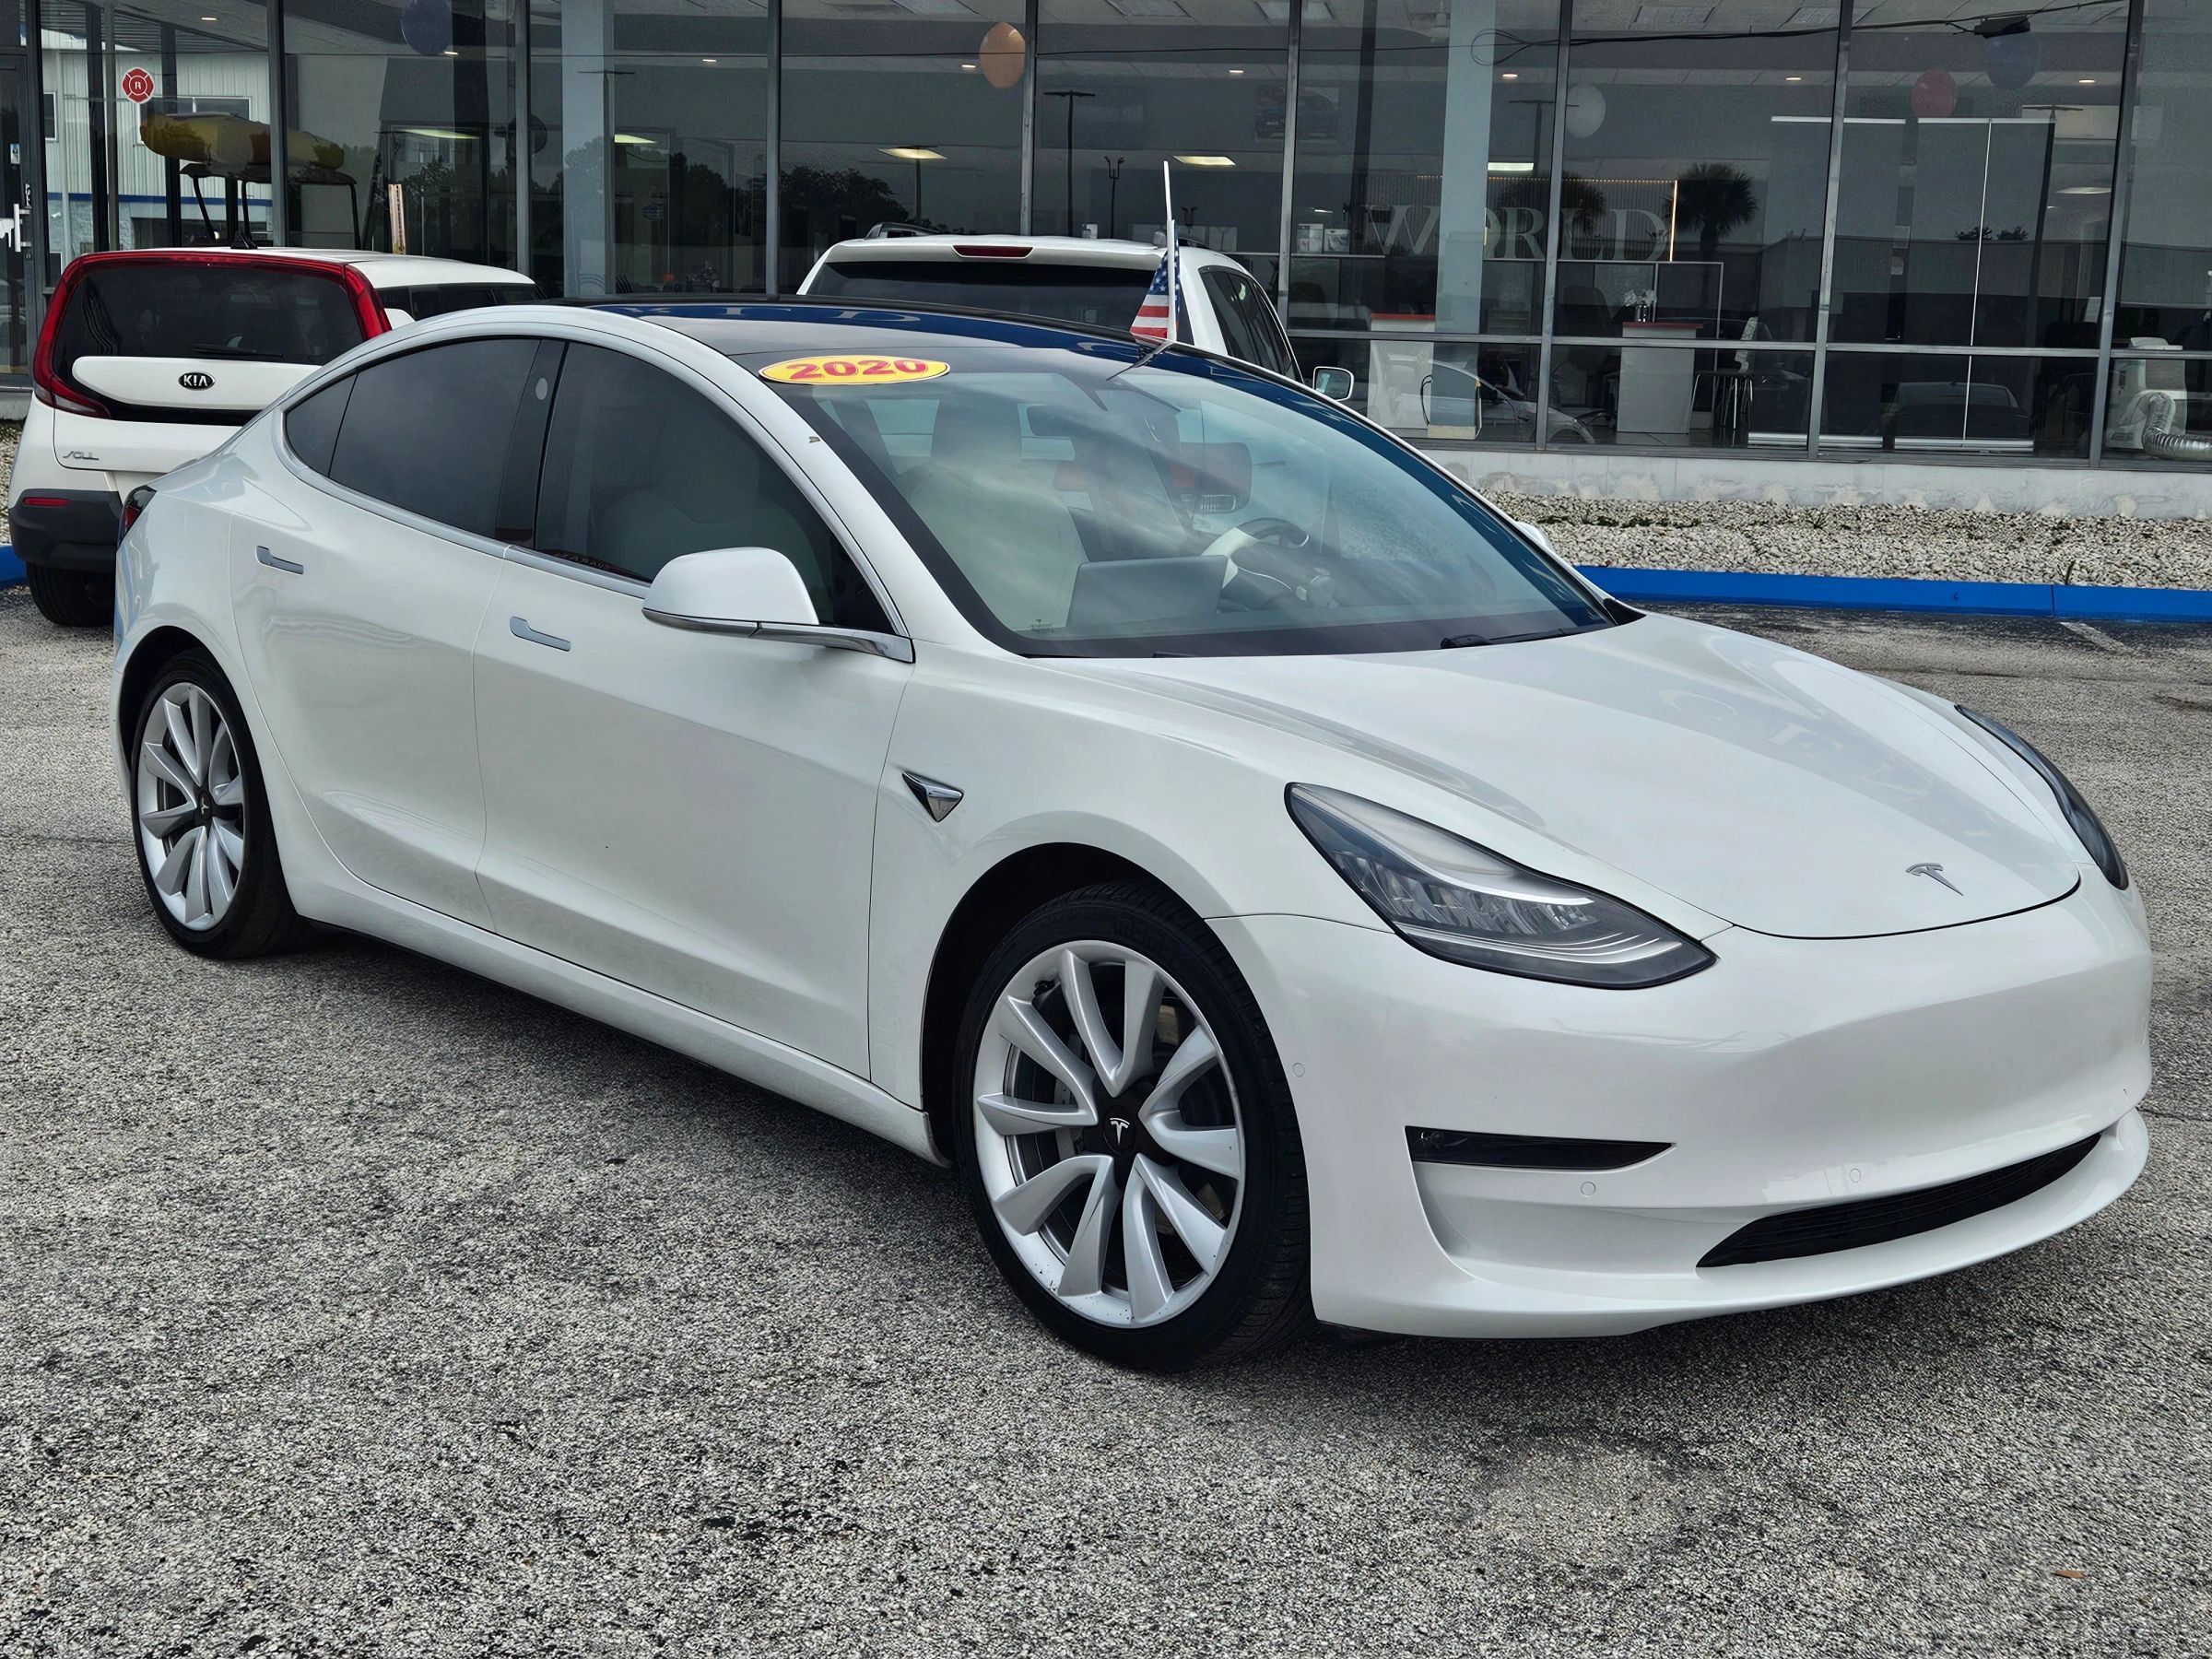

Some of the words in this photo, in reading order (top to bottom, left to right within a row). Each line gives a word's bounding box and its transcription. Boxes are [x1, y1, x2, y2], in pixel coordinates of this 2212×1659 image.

[1363, 204, 1668, 262] WRLD
[182, 373, 208, 387] KIA
[785, 359, 929, 380] 2020
